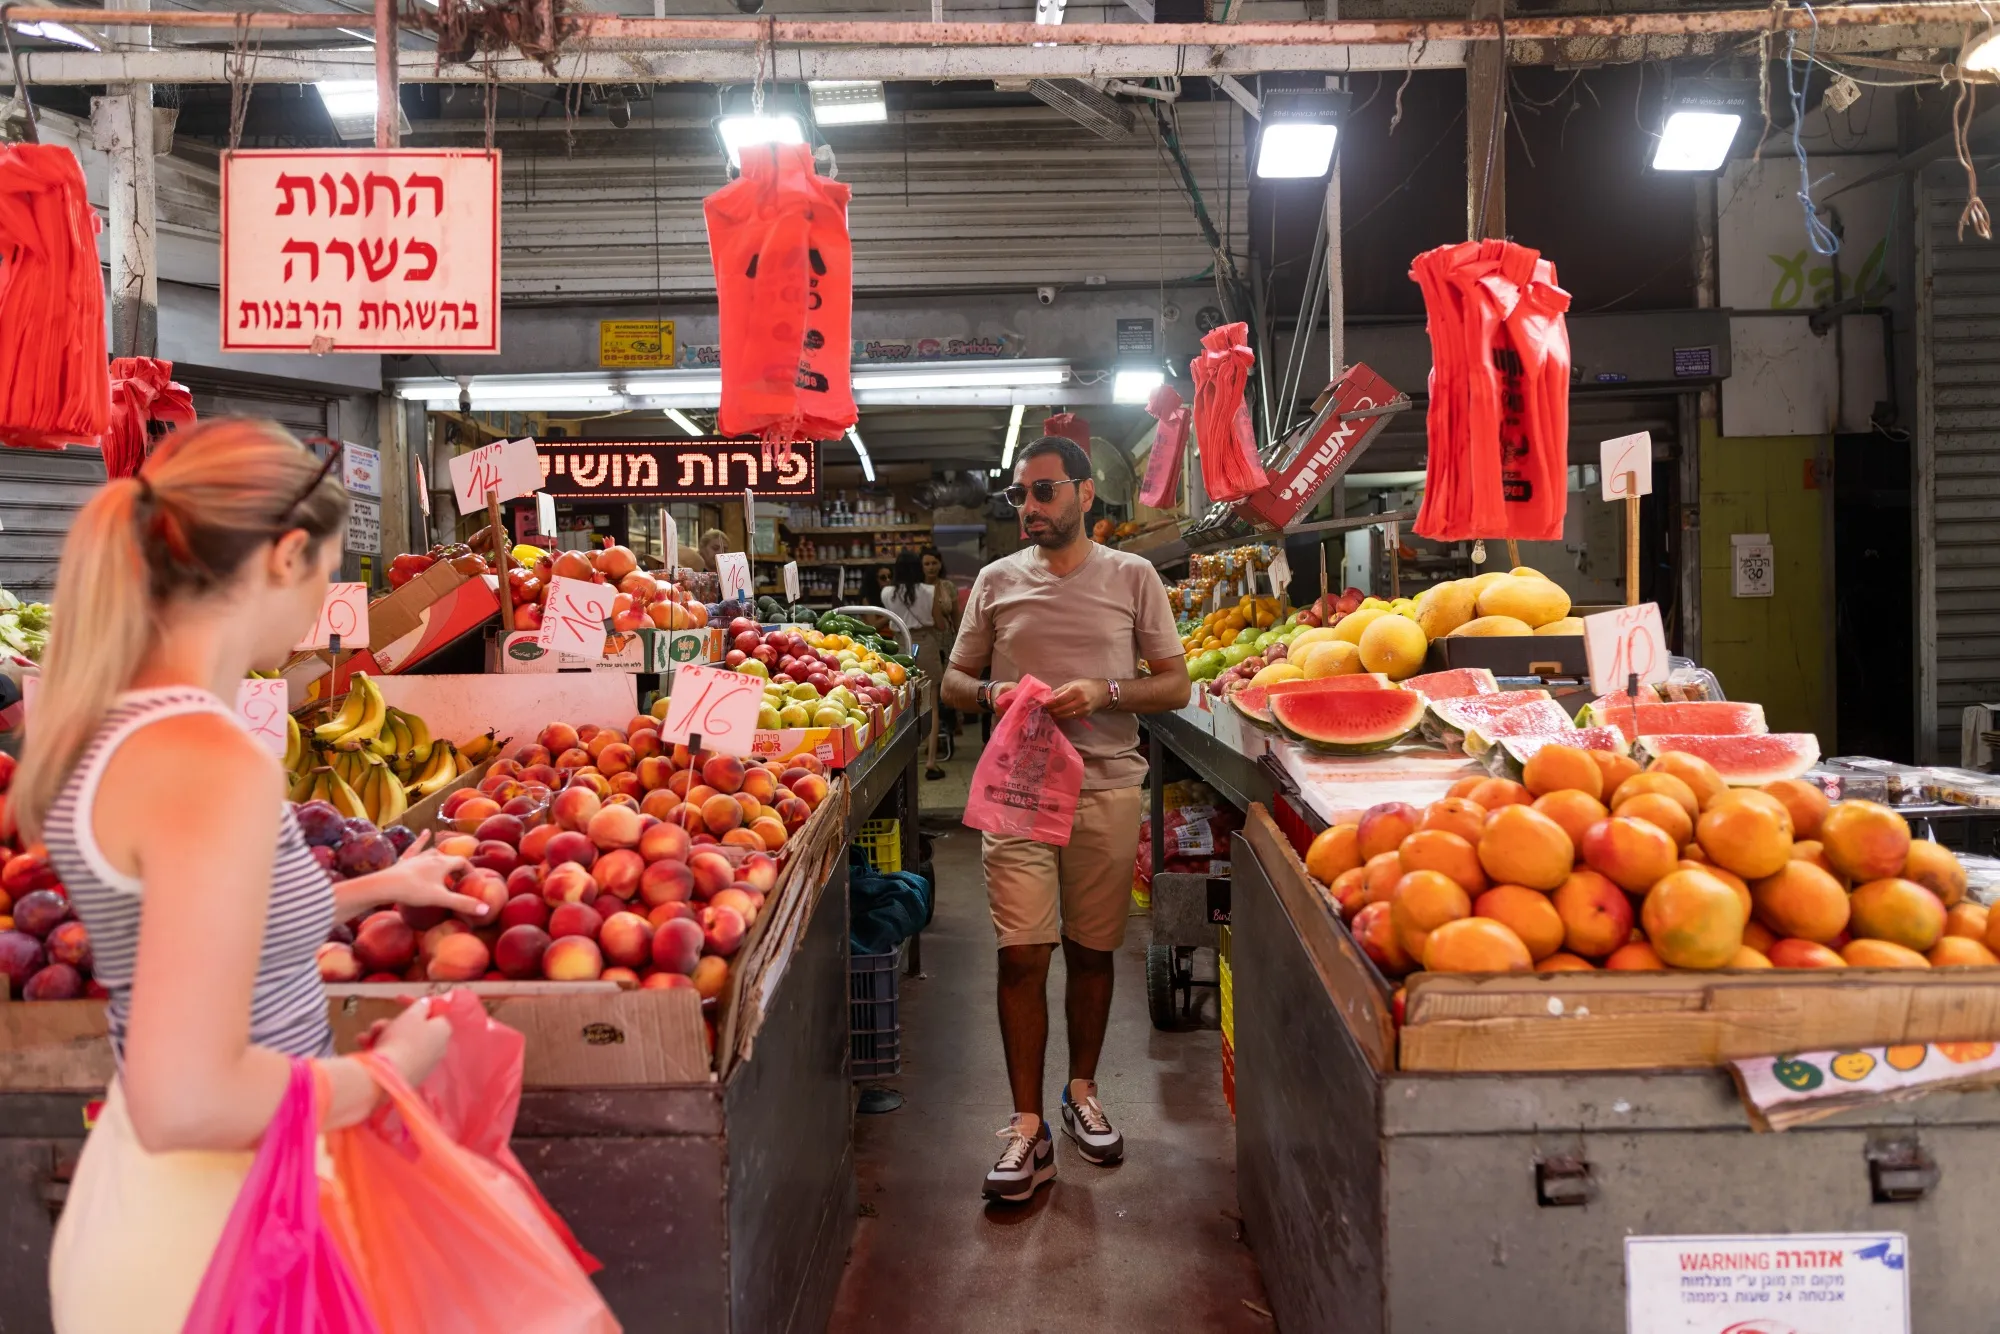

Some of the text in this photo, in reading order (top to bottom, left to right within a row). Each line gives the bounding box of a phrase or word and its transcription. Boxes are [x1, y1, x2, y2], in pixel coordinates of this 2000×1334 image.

[275, 171, 444, 218] החנות
[280, 236, 438, 283] כשרה
[238, 299, 479, 332] בהשגחת הרבנות
[866, 337, 1003, 359] Happy Birthday
[677, 452, 809, 488] פירות
[1609, 445, 1636, 494] 6
[466, 463, 503, 506] 14
[727, 563, 745, 596] 16
[1748, 567, 1764, 580] 30
[560, 594, 606, 644] 16
[1607, 625, 1656, 687] 10
[673, 681, 753, 737] 16
[753, 733, 780, 743] פירות
[1679, 1250, 1845, 1271] אזהרה WARNING
[1680, 1273, 1732, 1287] מצלמות
[1761, 1274, 1786, 1289] מוגן
[1791, 1274, 1806, 1286] זה
[1811, 1273, 1845, 1286] מקום
[1735, 1291, 1770, 1303] שעות
[1777, 1291, 1792, 1302] 24
[1799, 1289, 1845, 1303] אבטחה
